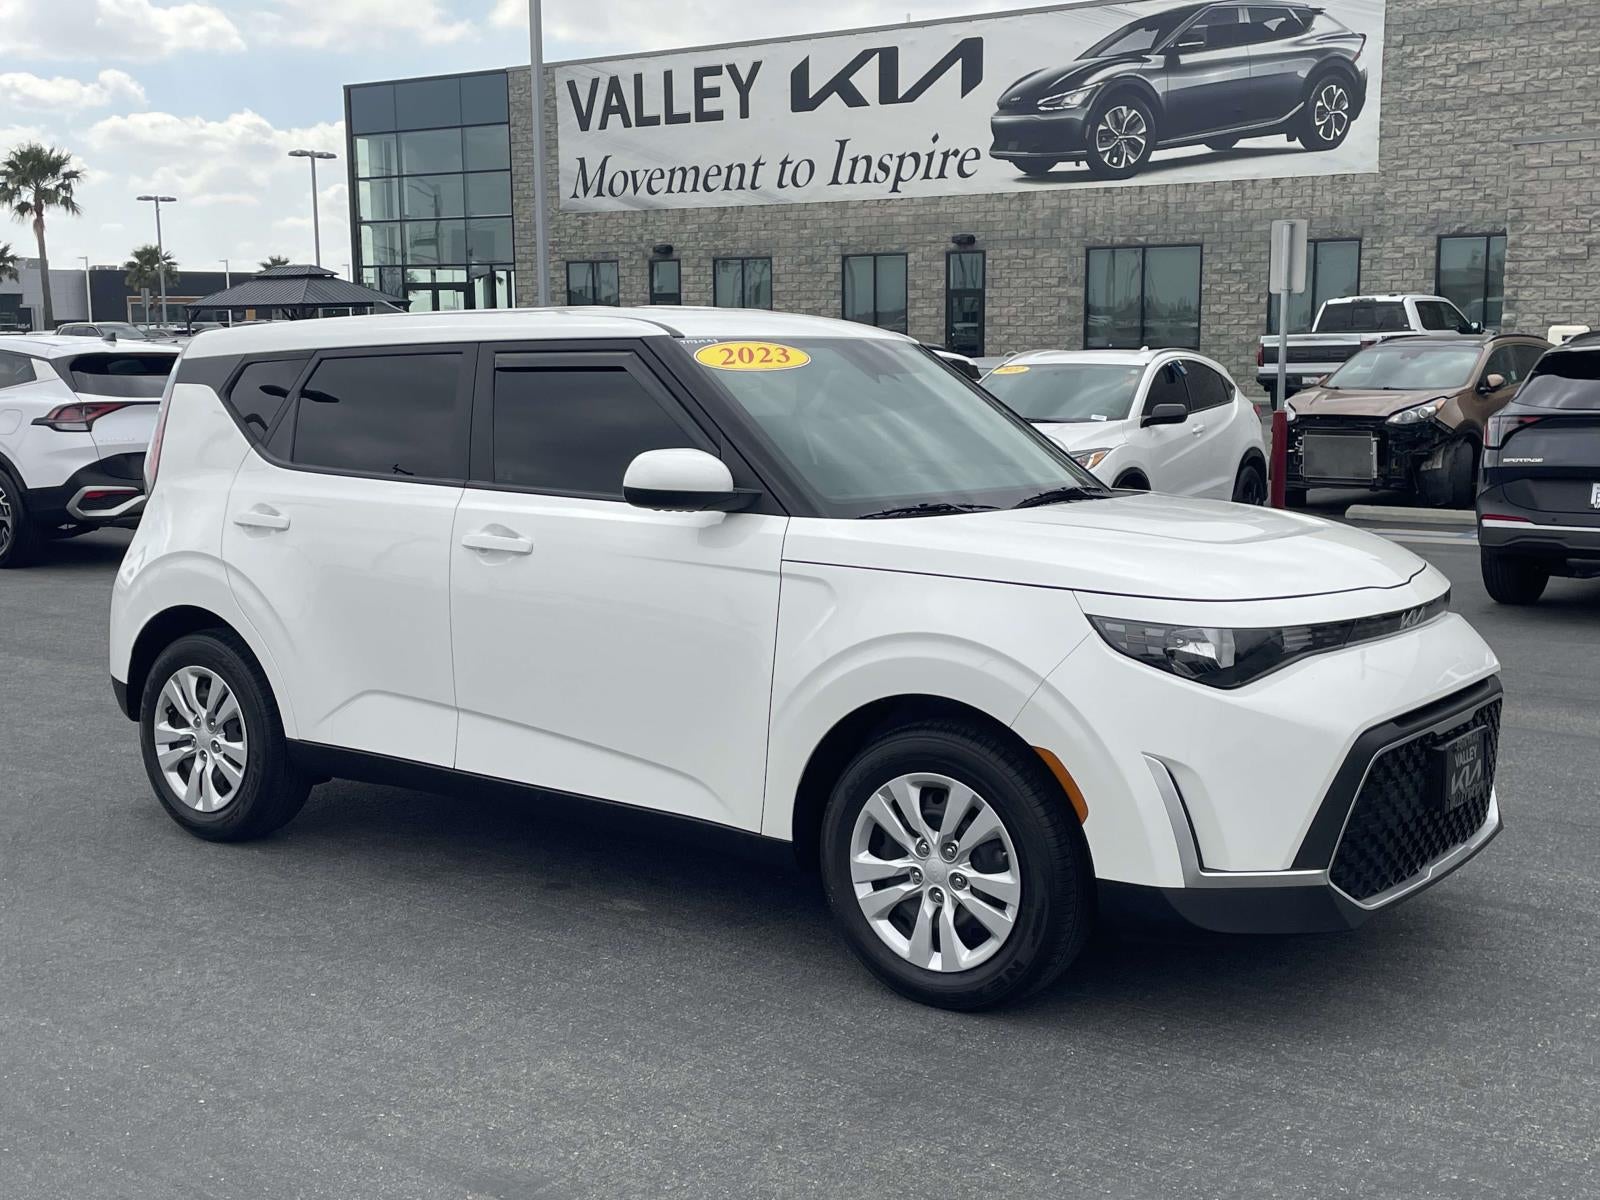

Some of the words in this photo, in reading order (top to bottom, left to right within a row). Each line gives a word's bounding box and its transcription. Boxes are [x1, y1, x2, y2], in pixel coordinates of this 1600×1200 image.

[567, 60, 763, 132] VALLEY
[790, 36, 984, 113] KIA
[570, 155, 766, 199] Movement
[776, 153, 815, 189] to
[827, 133, 981, 194] Inspire
[719, 346, 791, 366] 2023
[1400, 606, 1425, 629] KIA
[1454, 744, 1478, 768] VALLEY
[1451, 759, 1482, 795] KIA
